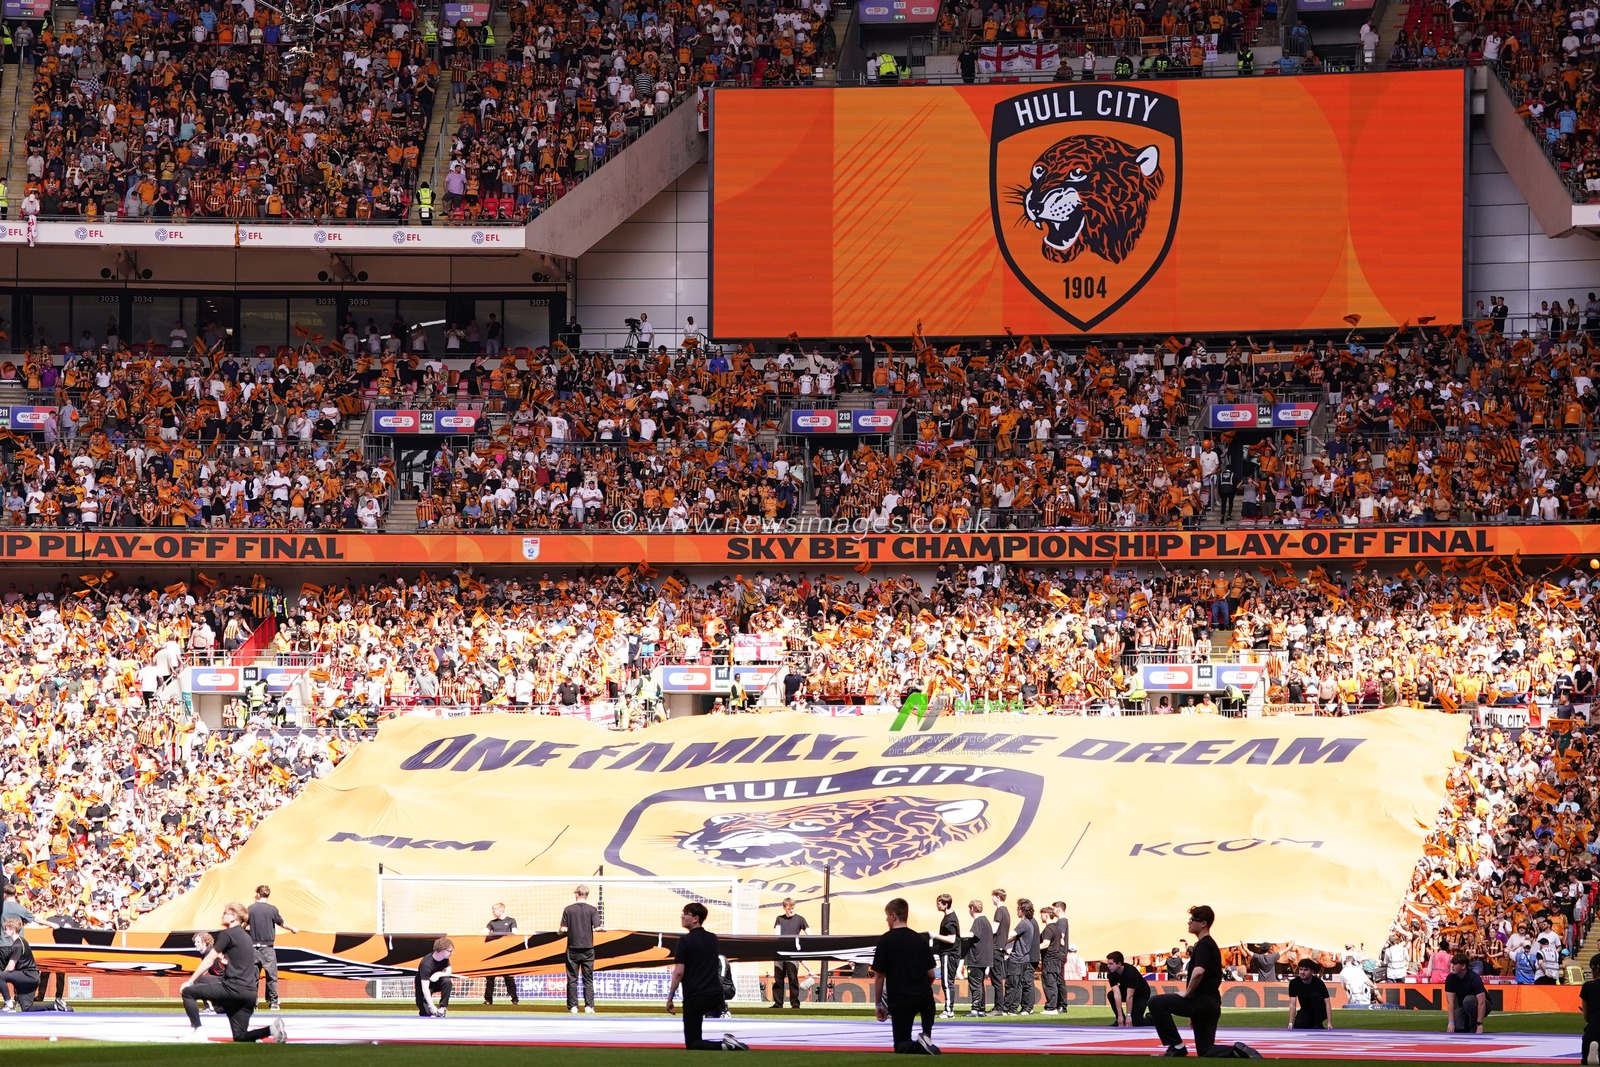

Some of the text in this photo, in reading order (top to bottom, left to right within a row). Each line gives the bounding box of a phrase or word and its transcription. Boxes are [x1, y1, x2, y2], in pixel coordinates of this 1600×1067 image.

[1014, 90, 1159, 126] HULL CITY
[1063, 276, 1106, 299] 1904
[1259, 407, 1270, 415] 214
[40, 536, 229, 558] PLAY-OFF
[236, 537, 343, 559] FINAL
[727, 530, 1494, 559] SKY BET CHAMPIONSHIP PLAY-OFF FINAL
[1200, 668, 1211, 676] 112
[1485, 713, 1526, 726] HULL CITY
[400, 732, 1368, 773] ONE FAMILY, ONE DREAM
[703, 765, 1005, 801] HULL CITY
[327, 832, 497, 851] MKM
[1129, 838, 1324, 856] KCOM
[522, 978, 543, 992] sky
[619, 980, 657, 994] TIME
